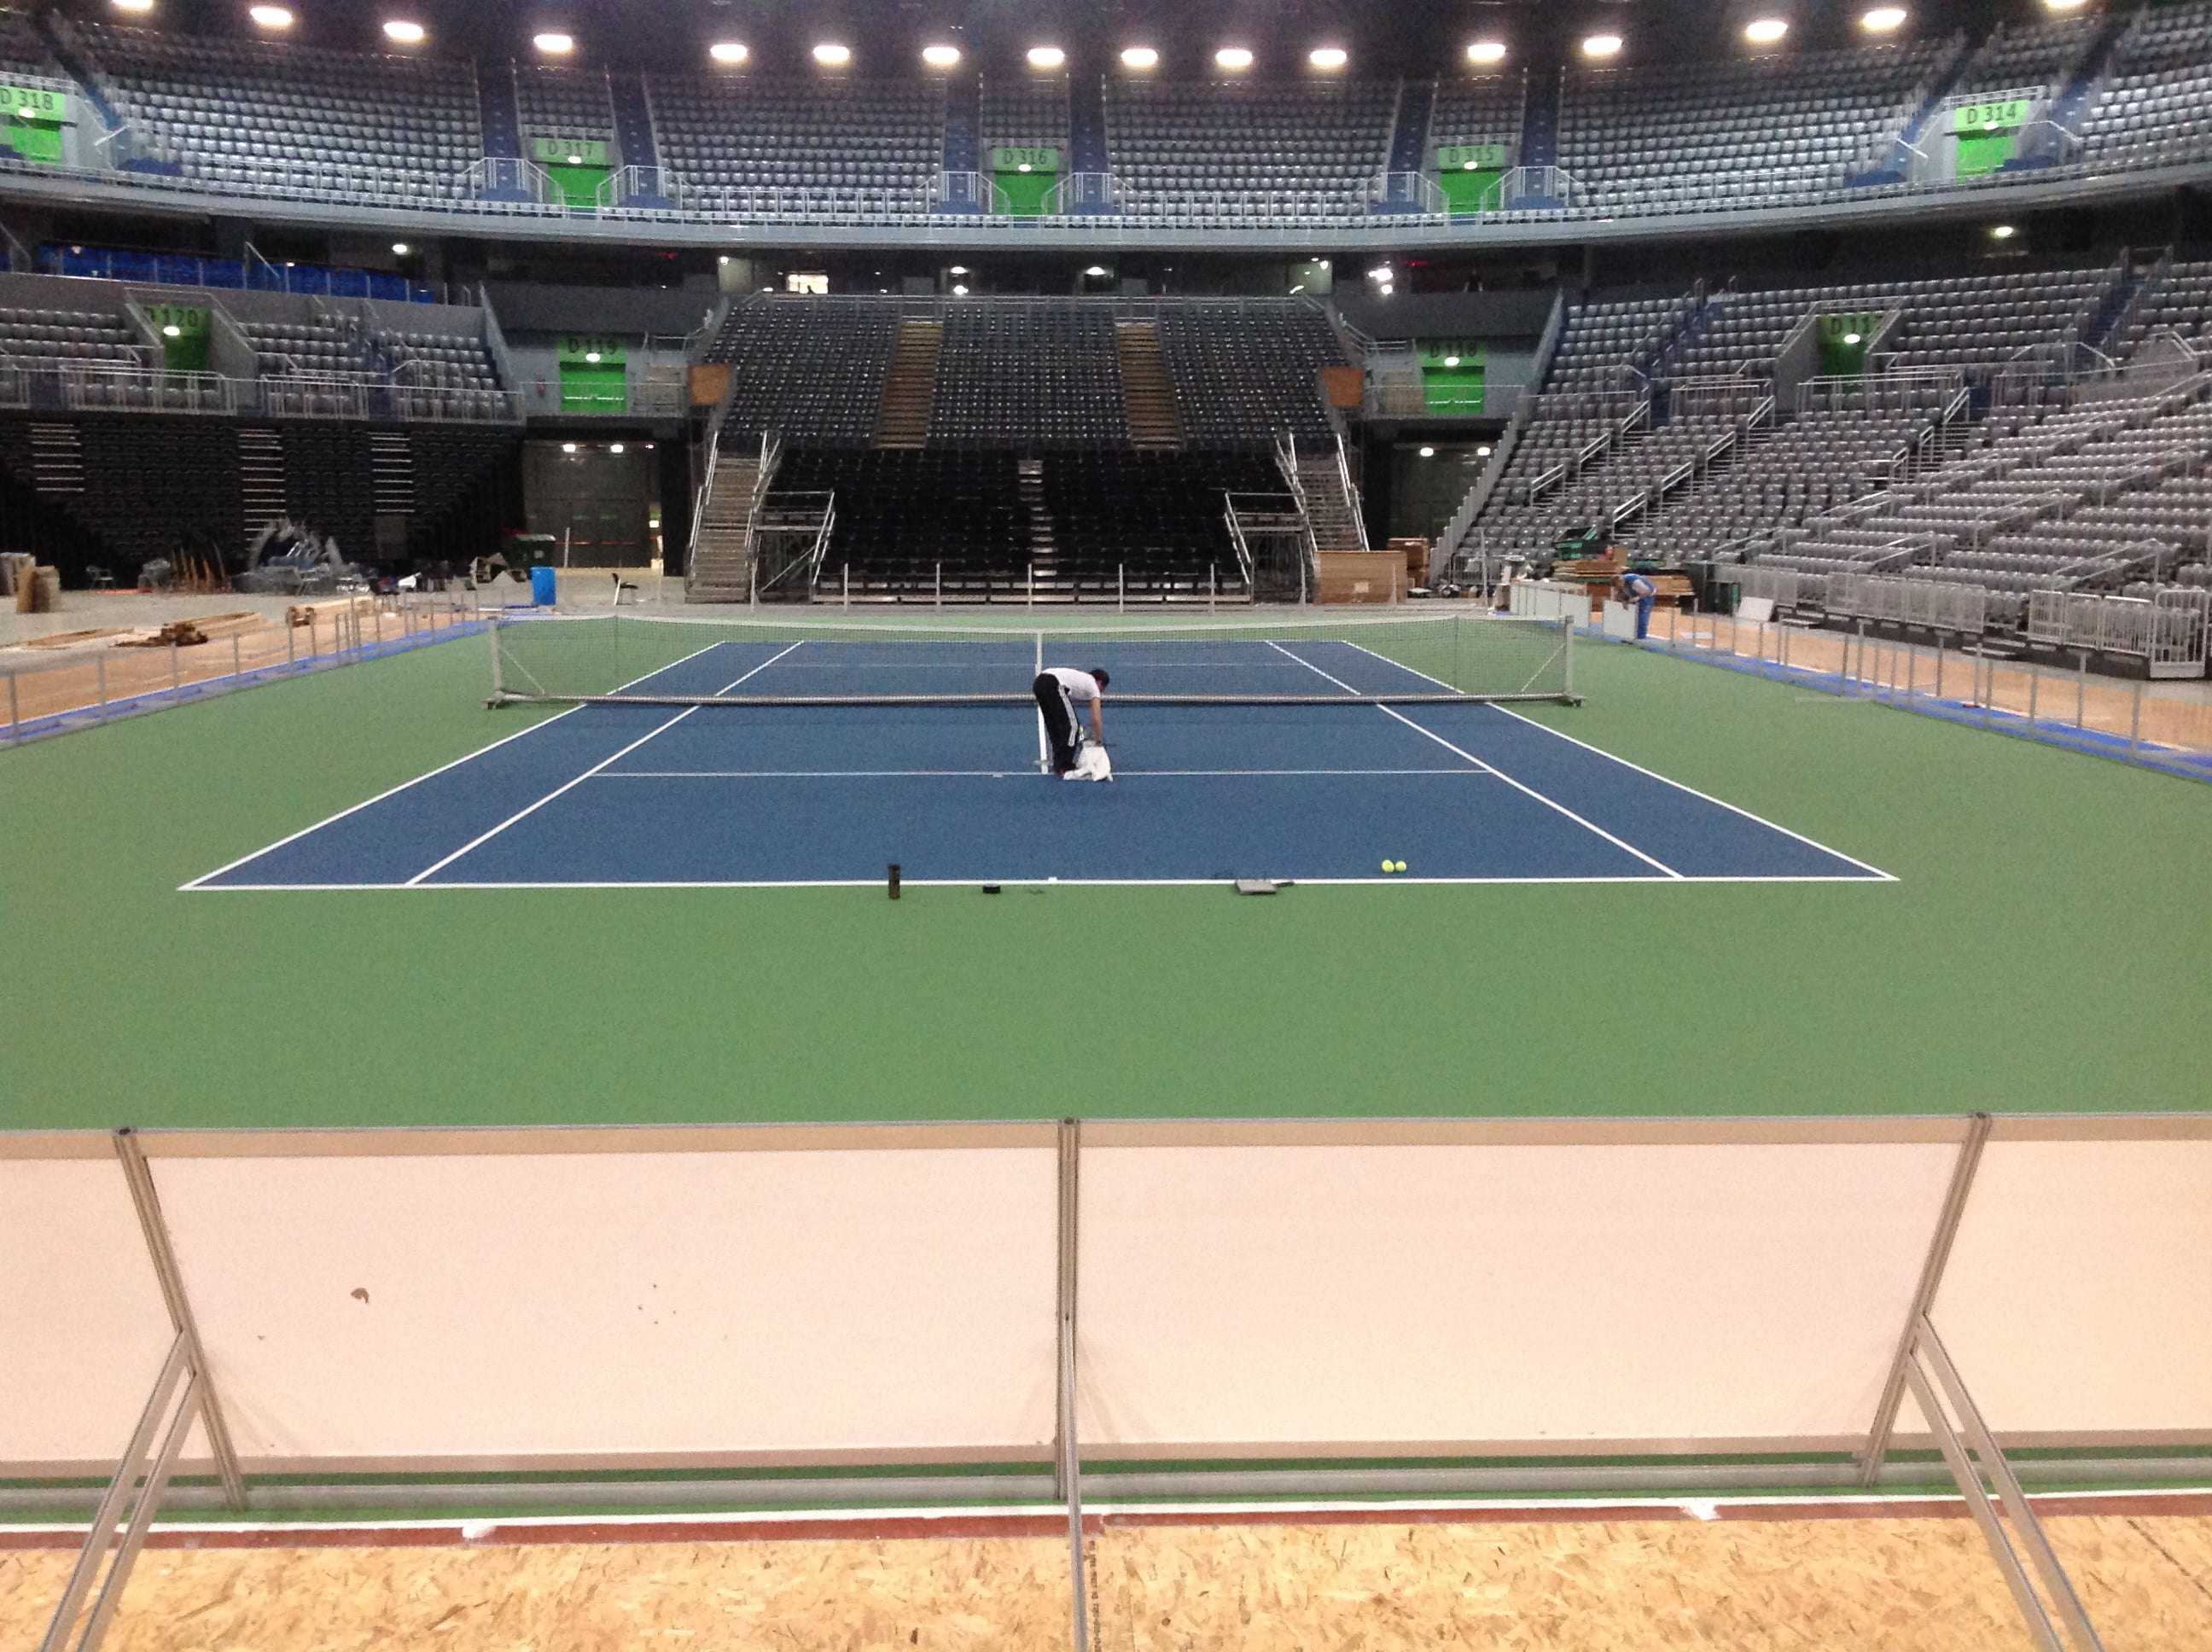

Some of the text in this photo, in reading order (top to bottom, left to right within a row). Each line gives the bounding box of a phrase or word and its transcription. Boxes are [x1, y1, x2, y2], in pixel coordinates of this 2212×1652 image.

[18, 90, 54, 110] 318
[1967, 103, 2017, 125] D 314
[547, 140, 592, 156] D 317
[1449, 146, 1493, 163] D 315
[1004, 149, 1047, 165] D 316
[162, 308, 198, 327] 120
[1831, 317, 1842, 334] D
[568, 337, 617, 355] D 119
[1430, 342, 1441, 358] D
